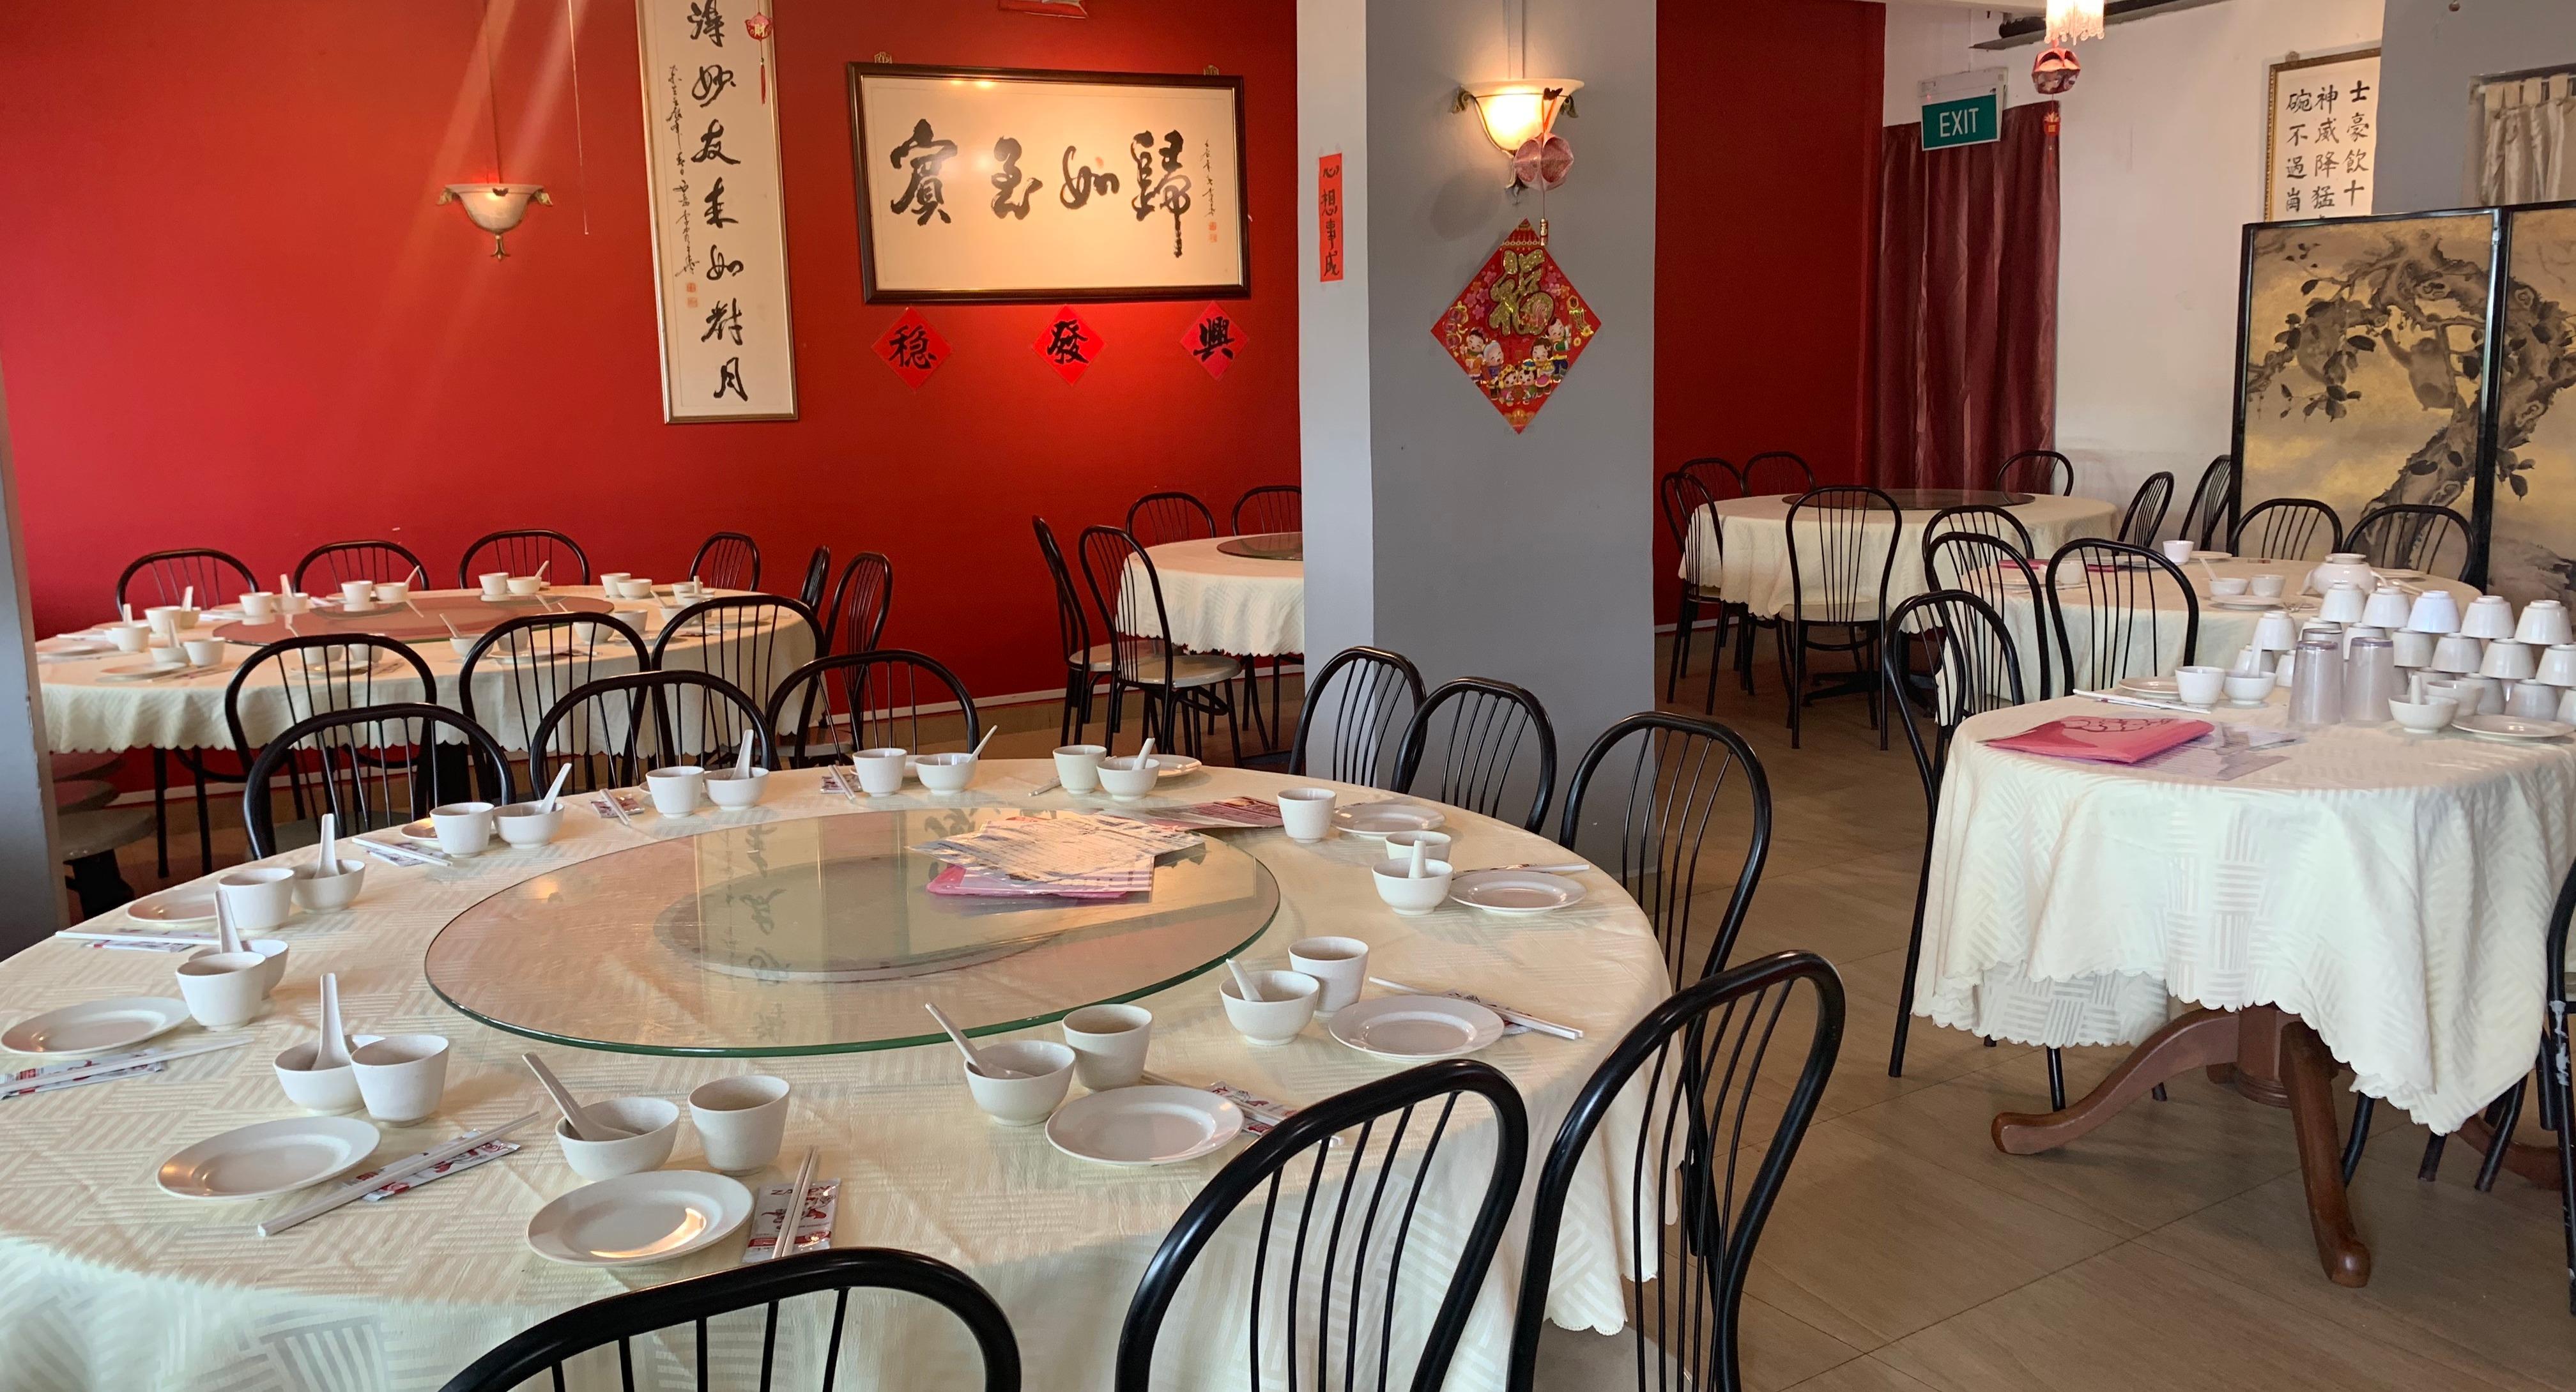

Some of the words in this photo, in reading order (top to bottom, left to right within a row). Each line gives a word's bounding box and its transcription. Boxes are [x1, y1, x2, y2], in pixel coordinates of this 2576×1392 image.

[1939, 107, 1979, 138] EXIT
[2311, 84, 2340, 218] 神威降猛
[1488, 248, 1554, 337] 福
[1046, 319, 1089, 365] 發
[1193, 316, 1235, 362] 興
